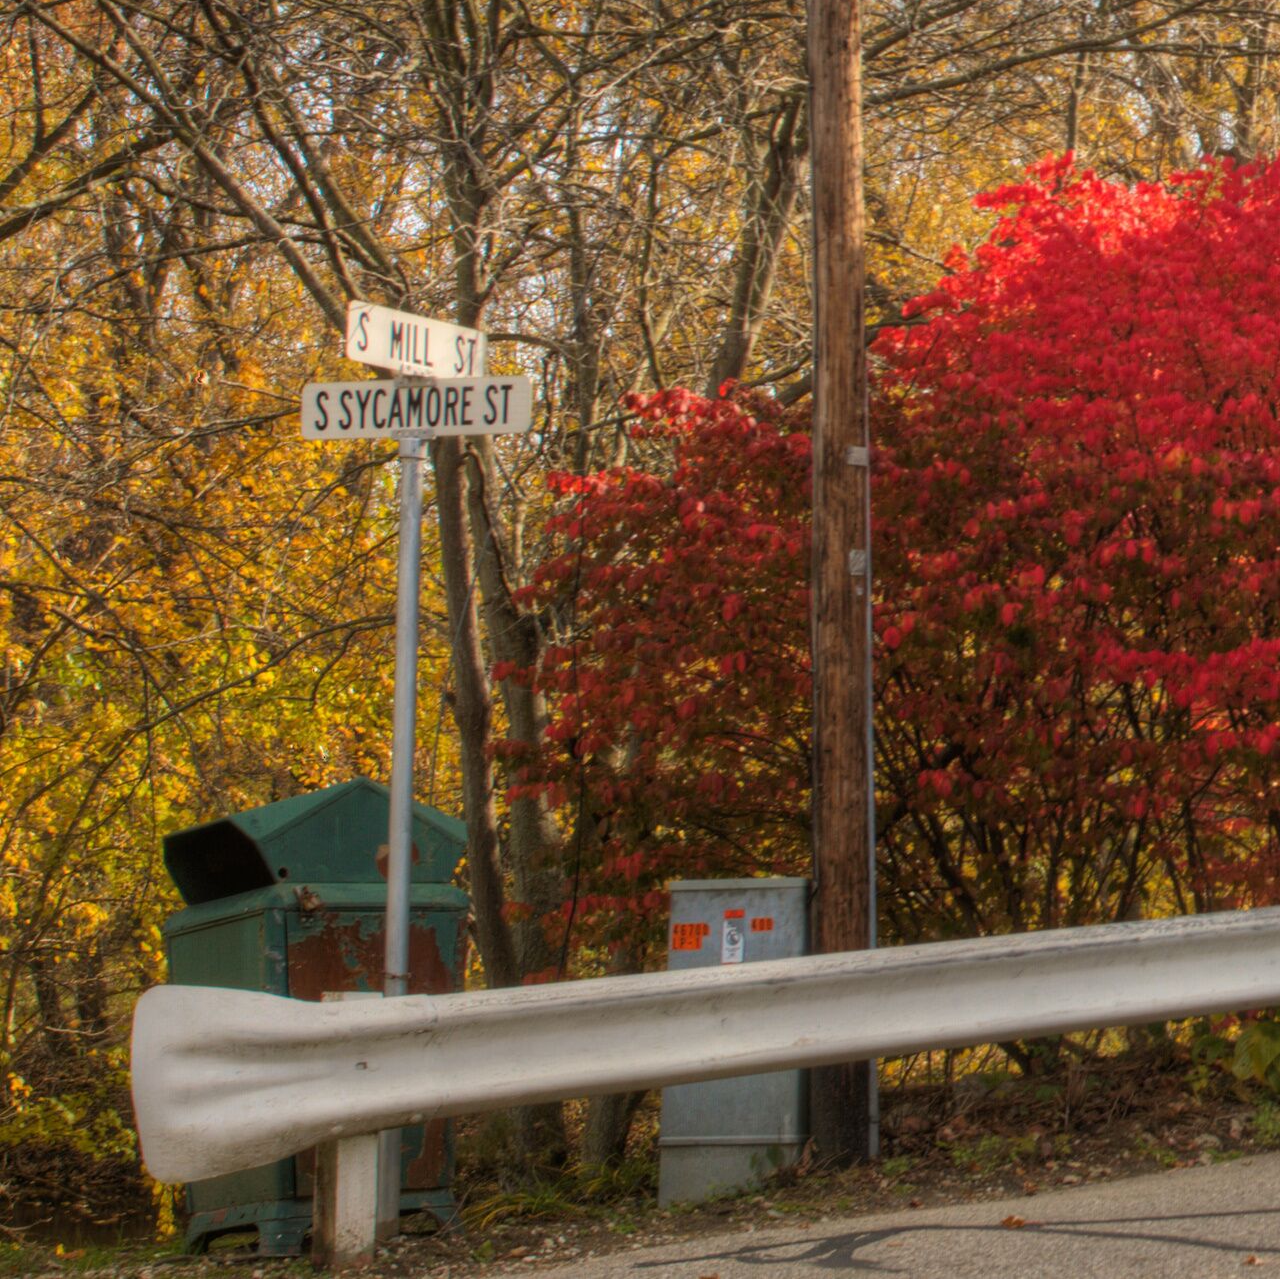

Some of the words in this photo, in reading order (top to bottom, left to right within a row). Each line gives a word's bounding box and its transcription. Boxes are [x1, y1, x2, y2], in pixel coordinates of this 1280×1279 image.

[356, 312, 370, 352] S
[390, 320, 433, 367] MILL
[454, 334, 477, 376] ST
[314, 390, 329, 430] S
[338, 385, 474, 430] SYCAMORE
[483, 384, 513, 424] ST
